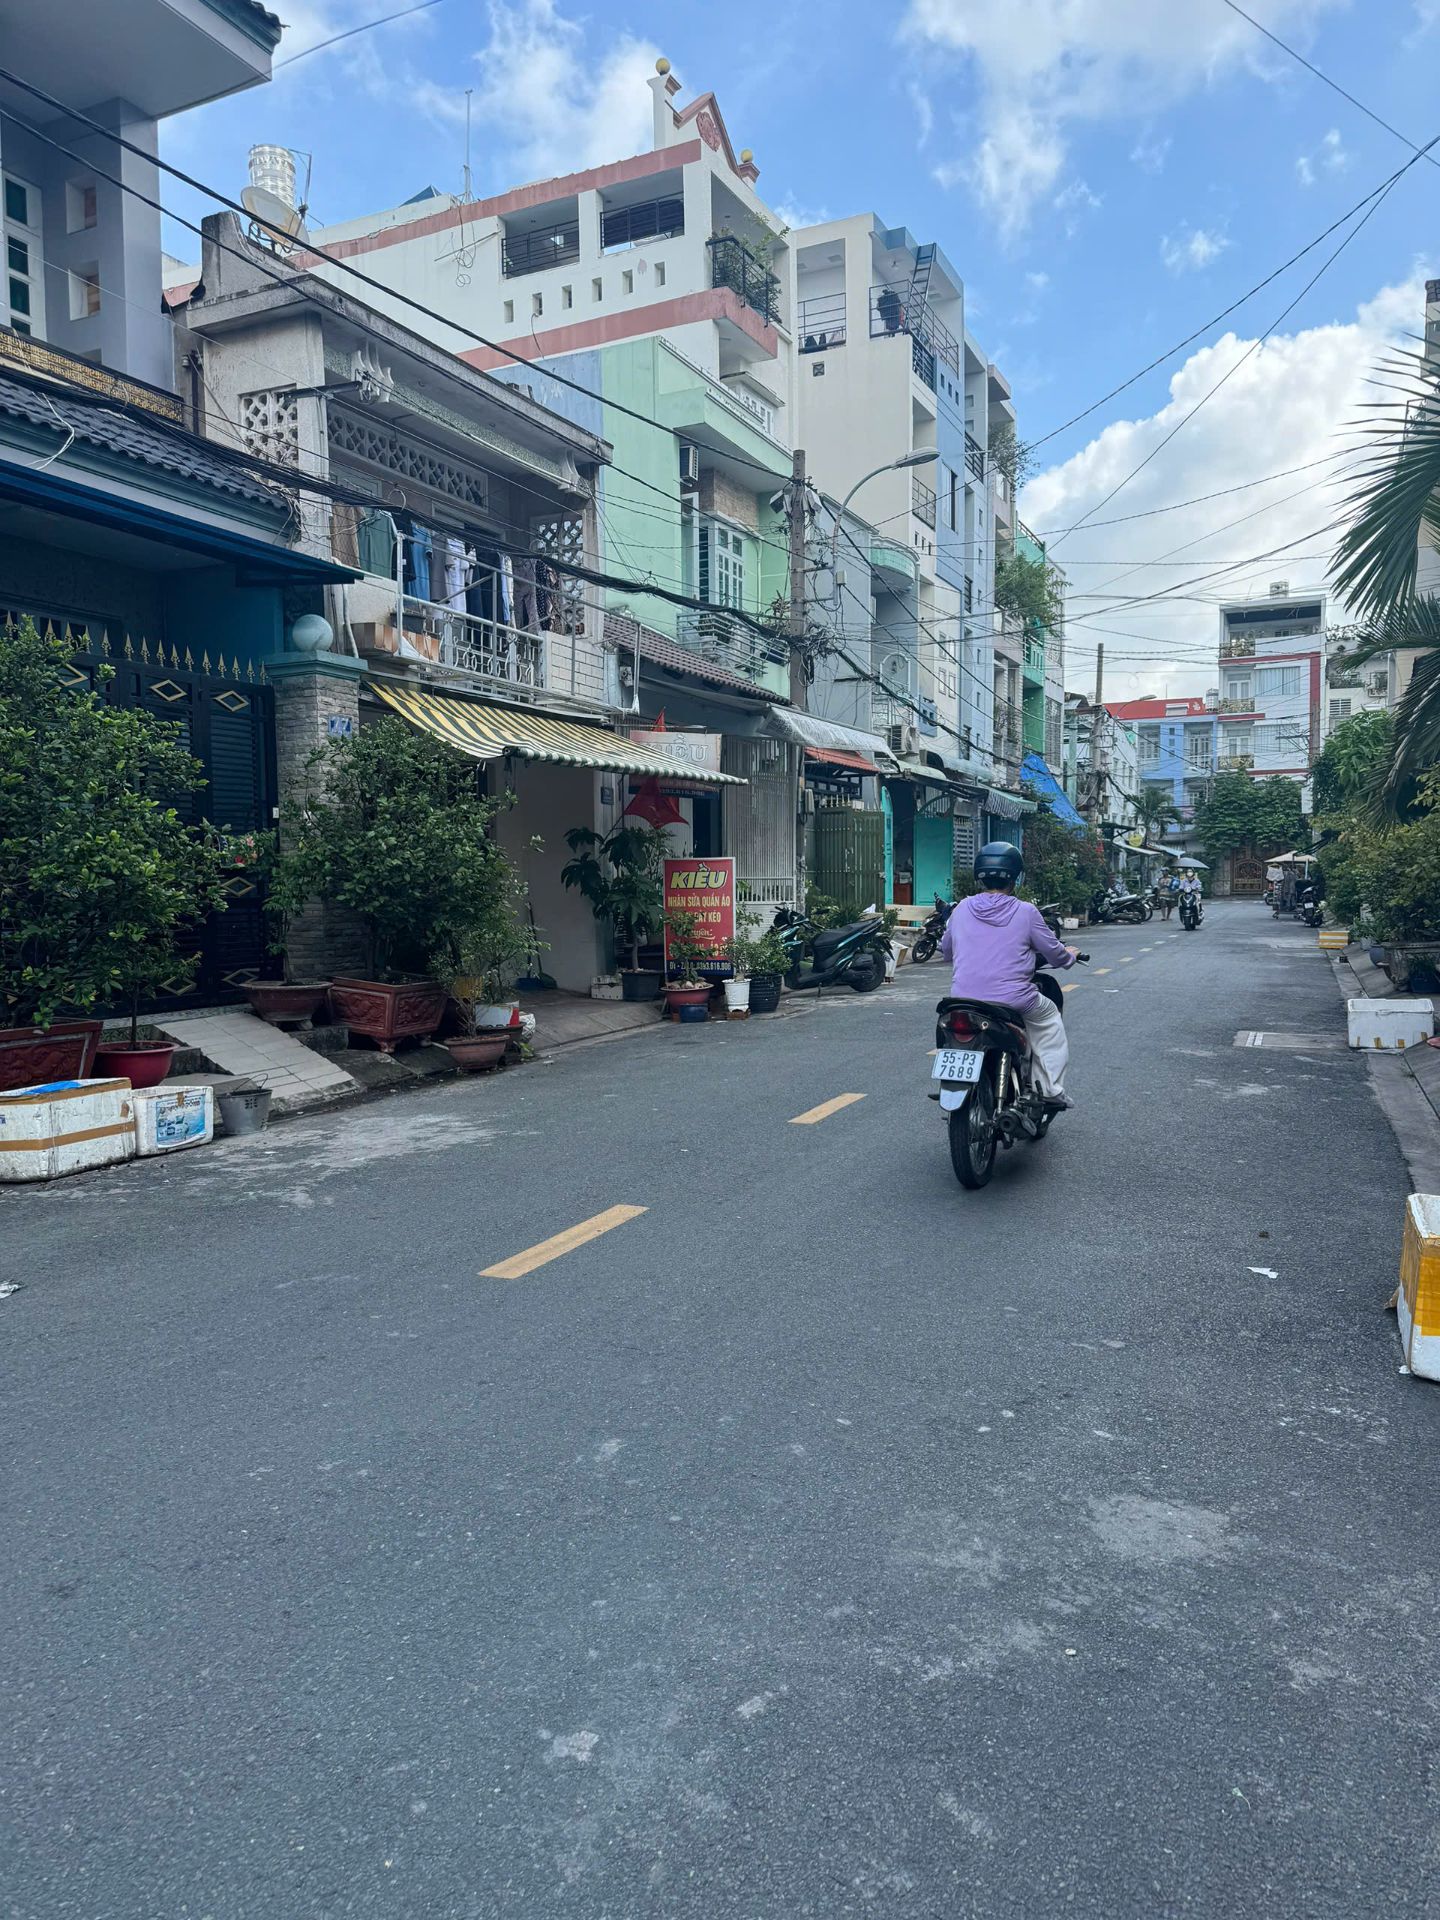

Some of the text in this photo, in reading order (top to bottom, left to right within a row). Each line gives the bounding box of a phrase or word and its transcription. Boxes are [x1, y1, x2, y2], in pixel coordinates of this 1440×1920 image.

[671, 862, 728, 889] KIỀU
[942, 1052, 976, 1065] 55-P3
[940, 1065, 974, 1079] 7689
